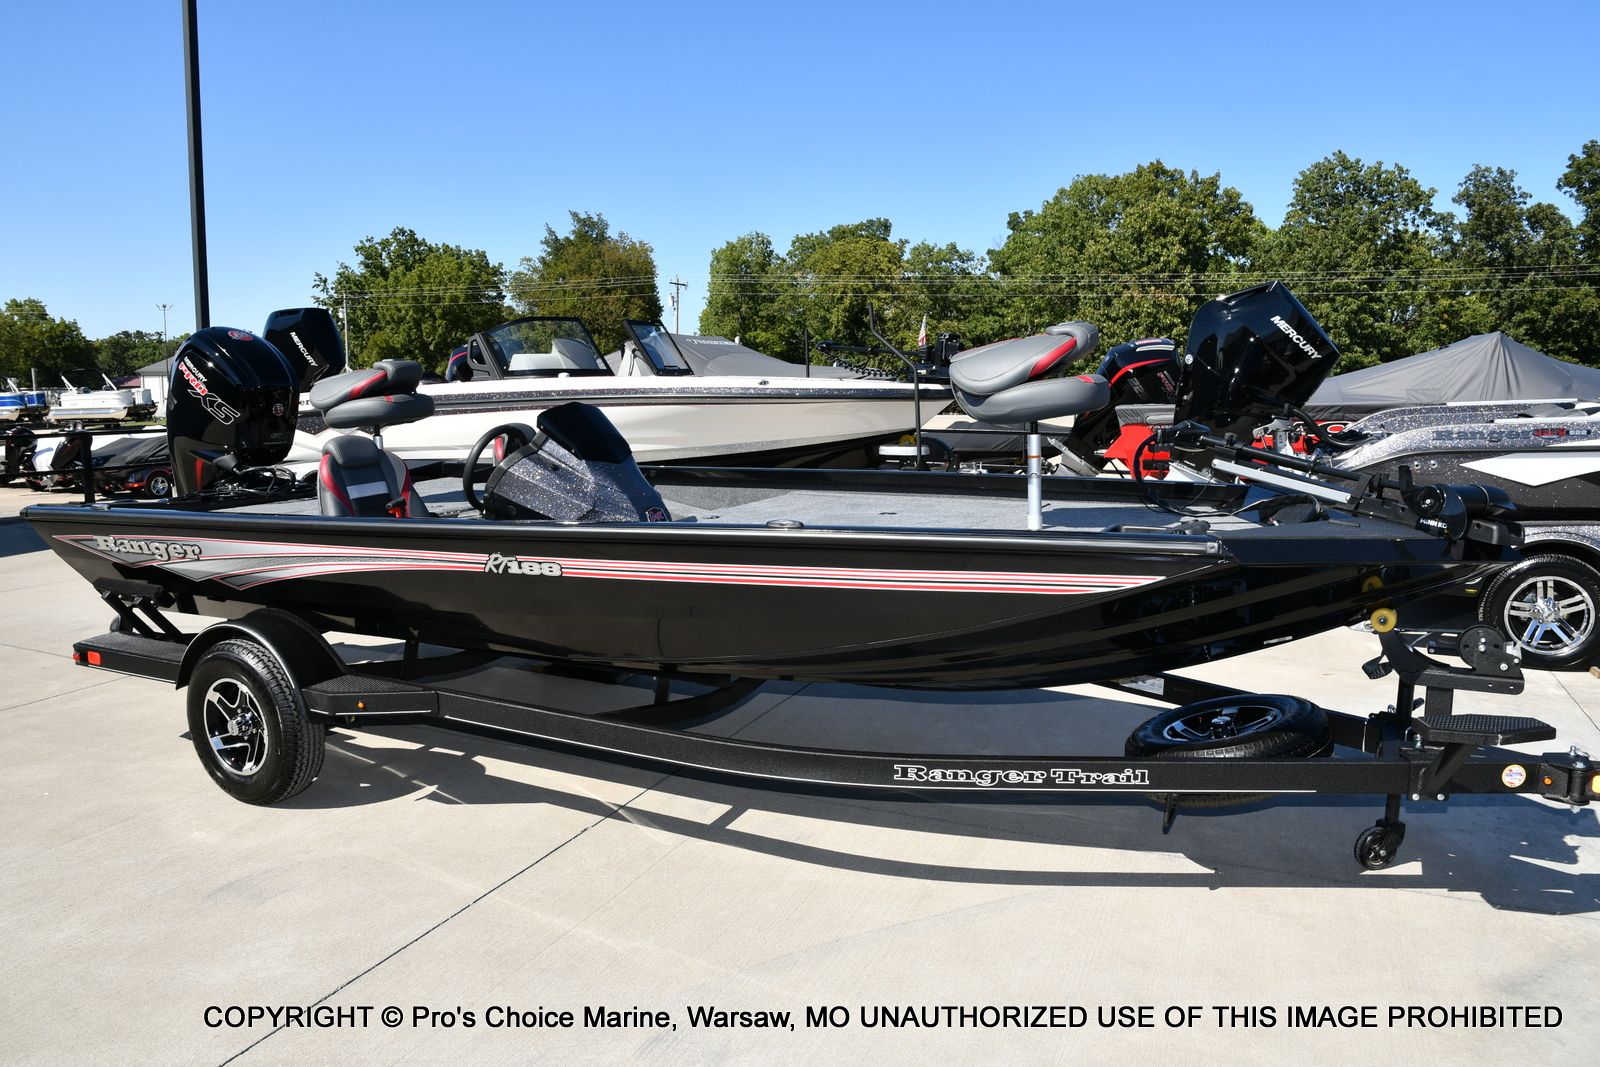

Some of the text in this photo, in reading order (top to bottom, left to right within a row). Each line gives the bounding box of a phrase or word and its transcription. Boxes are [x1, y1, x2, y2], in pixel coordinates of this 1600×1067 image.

[290, 331, 318, 367] MERCURY
[1270, 315, 1322, 359] MERCURY
[178, 361, 208, 396] PRO
[183, 356, 207, 382] MERCURY
[188, 389, 241, 425] XS
[1432, 430, 1532, 443] Ranger
[94, 535, 201, 561] Ranger
[484, 552, 562, 577] RT188
[893, 764, 1150, 787] Ranger Trail
